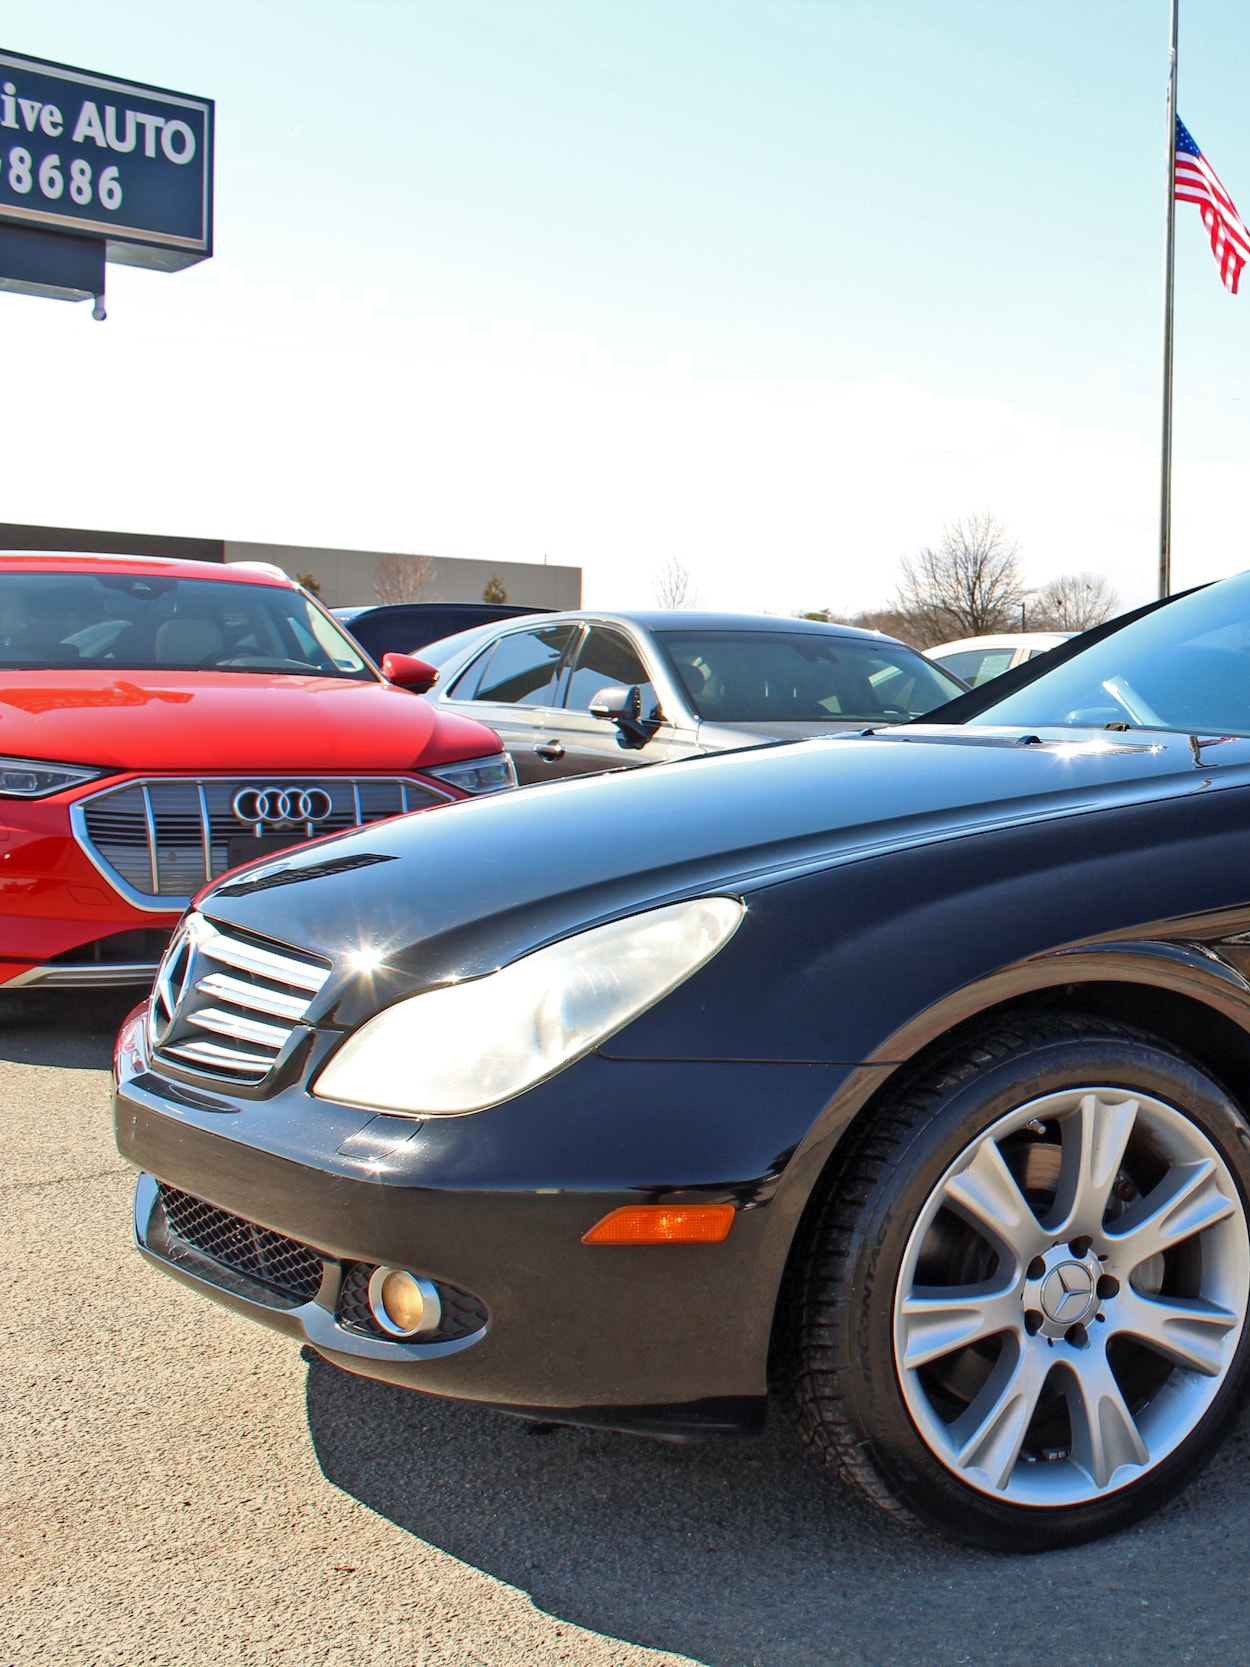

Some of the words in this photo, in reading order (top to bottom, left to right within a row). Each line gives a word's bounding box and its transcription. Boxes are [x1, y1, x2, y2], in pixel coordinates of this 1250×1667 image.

[0, 82, 64, 137] ive
[72, 100, 196, 165] AUTO
[0, 146, 123, 211] 8686
